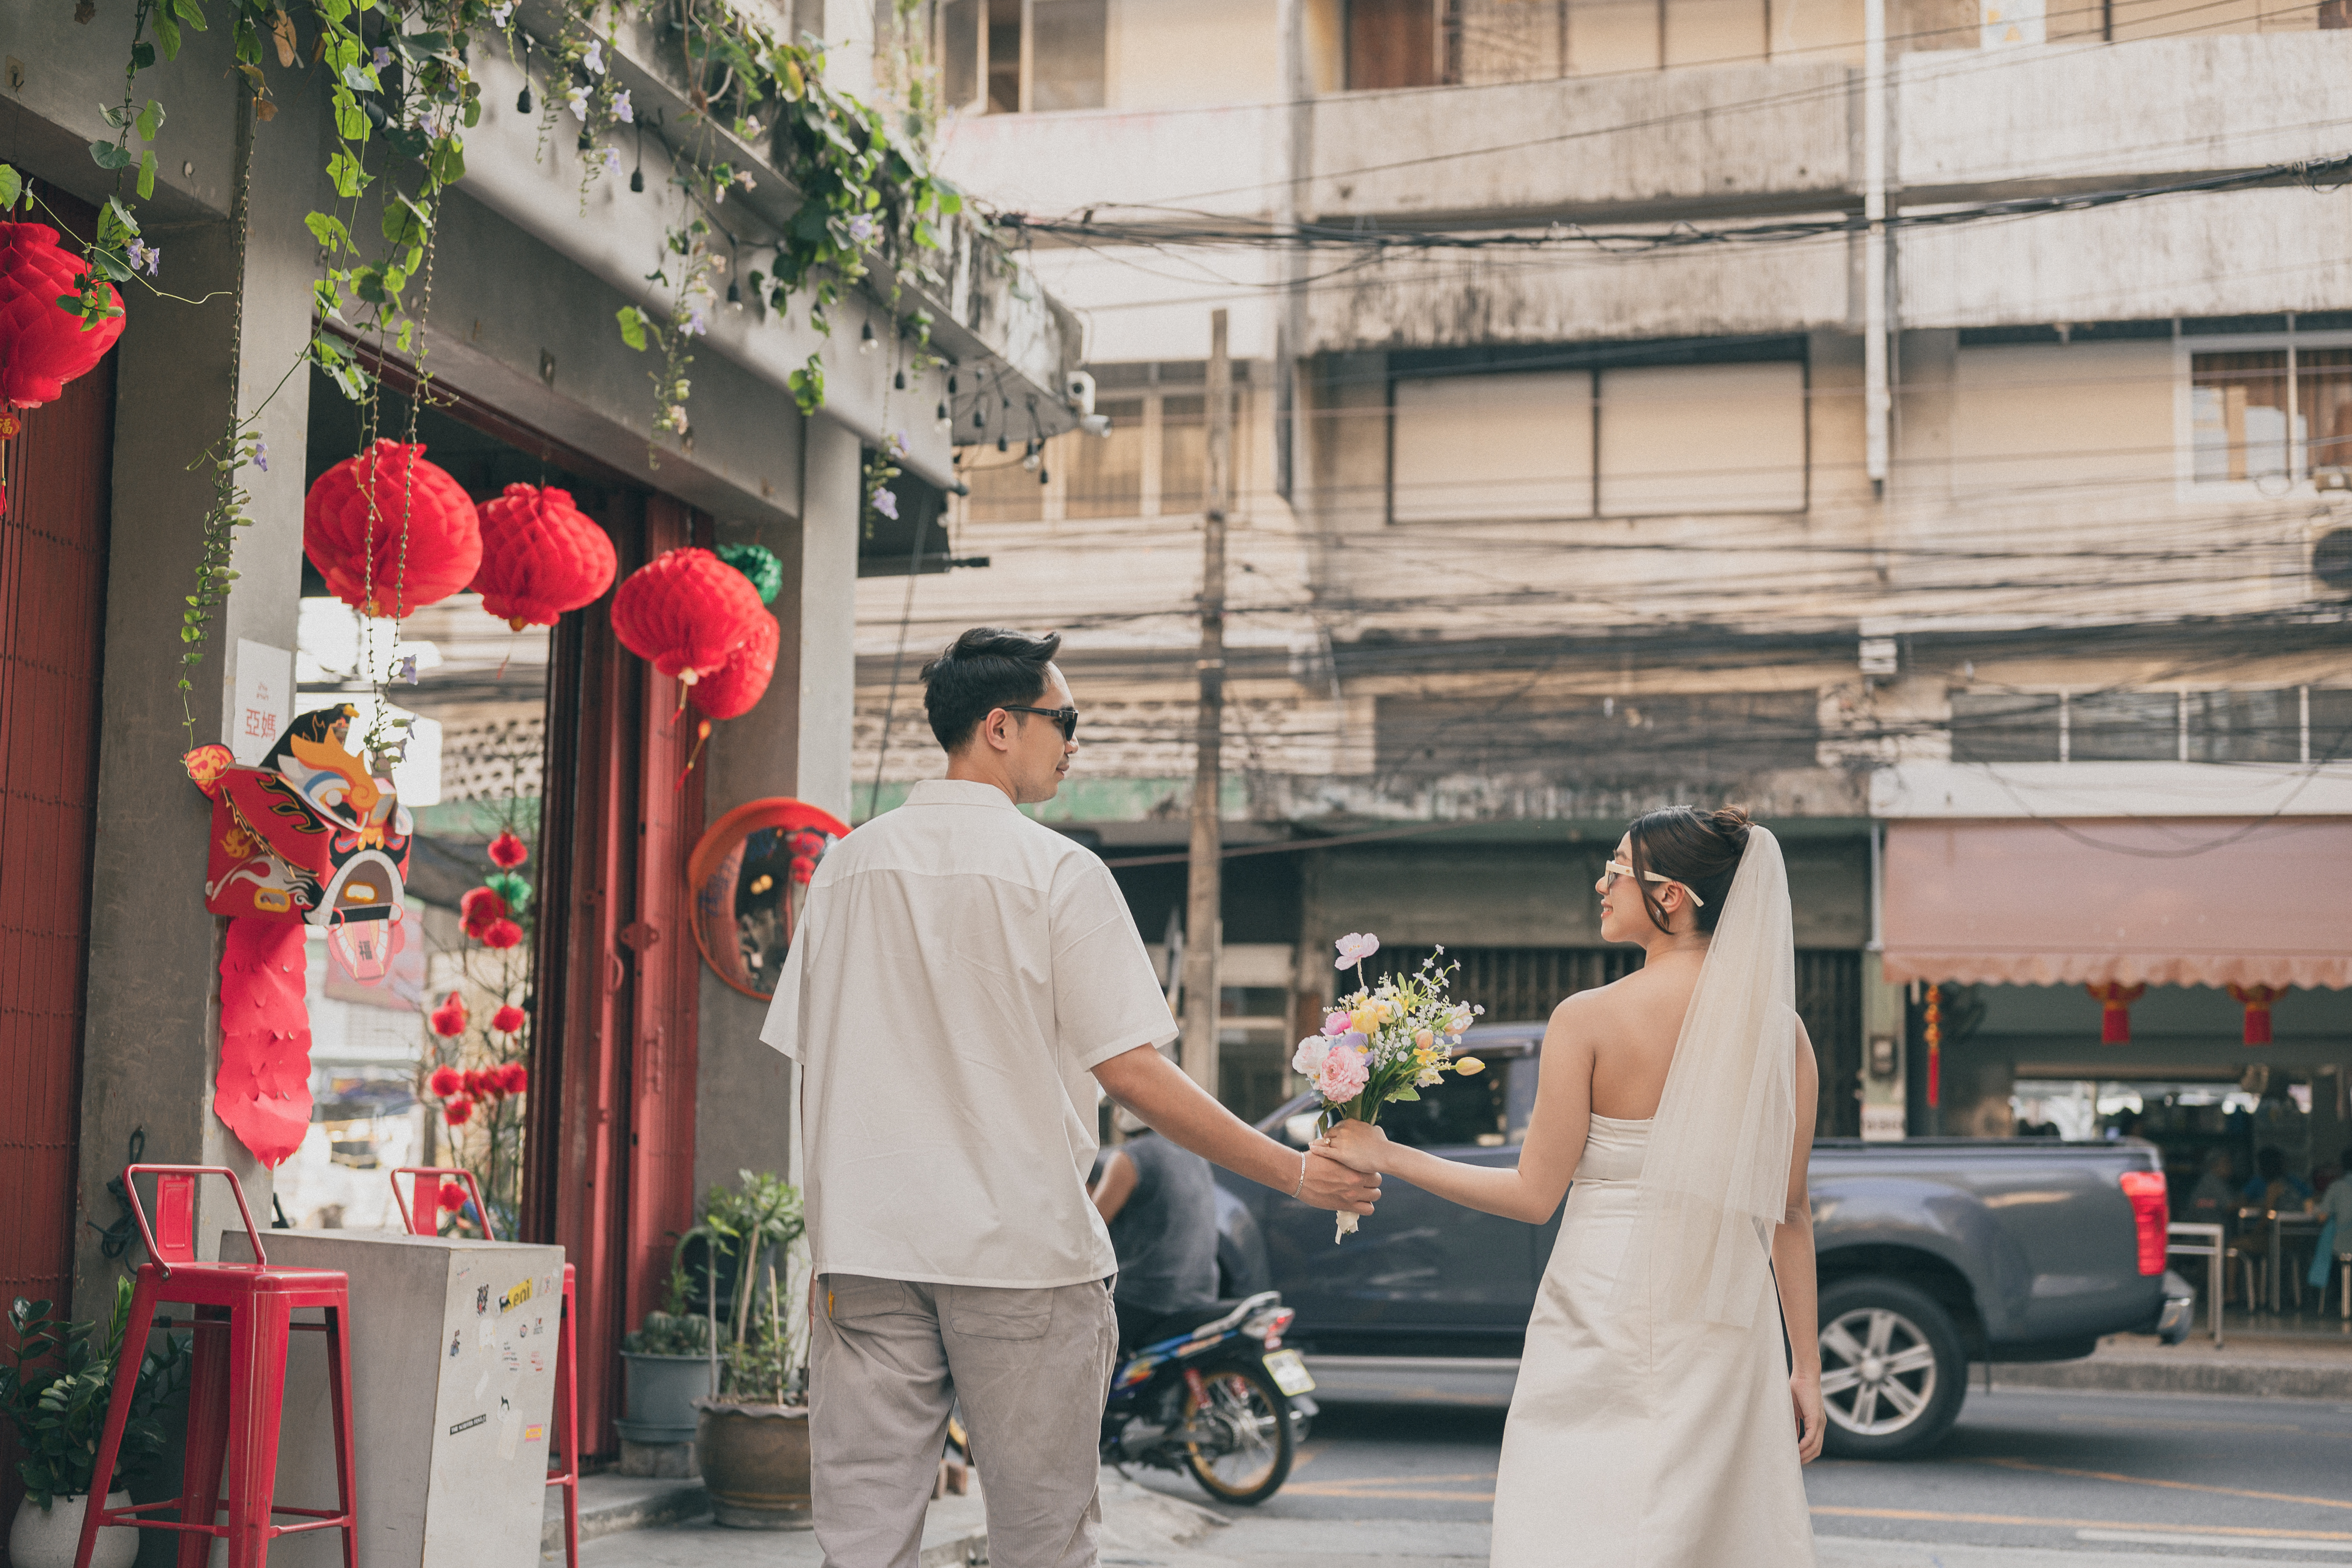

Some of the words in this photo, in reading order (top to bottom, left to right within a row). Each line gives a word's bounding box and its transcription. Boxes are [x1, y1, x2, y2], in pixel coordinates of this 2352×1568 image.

[245, 708, 276, 742] 亞媽
[359, 940, 373, 961] 福
[514, 1279, 529, 1307] eni
